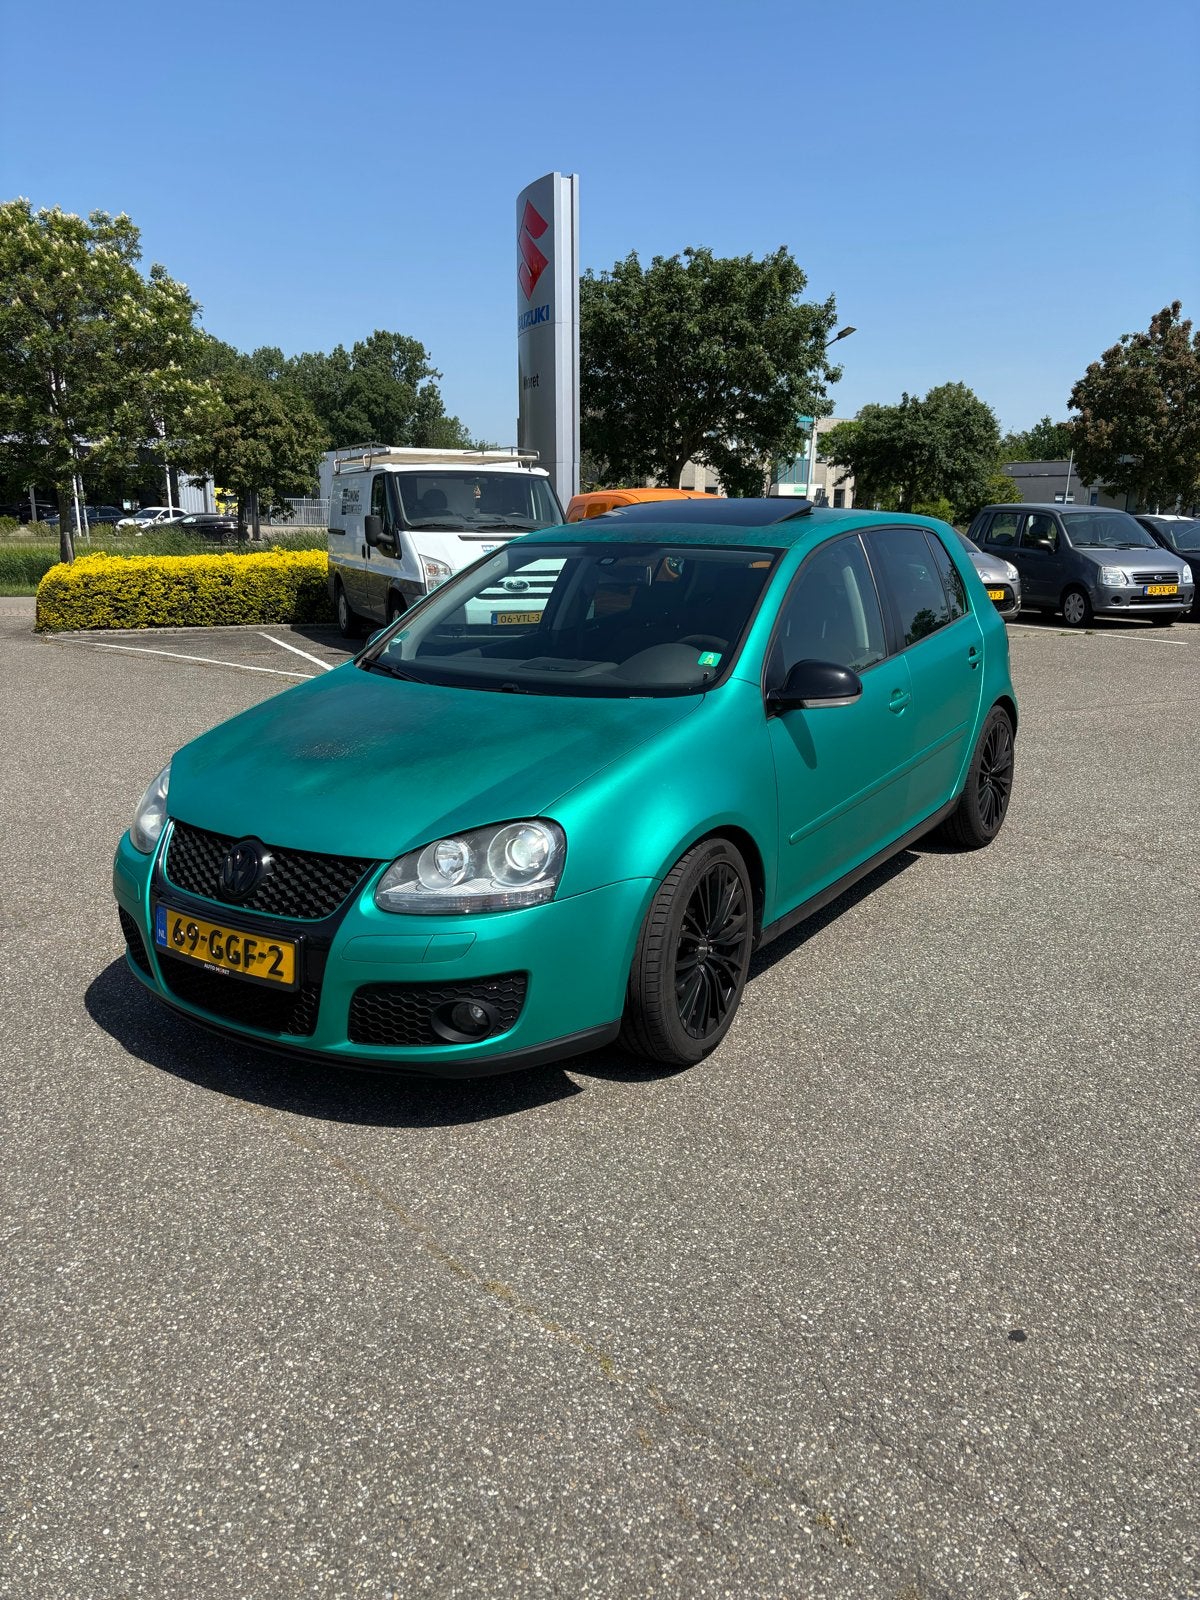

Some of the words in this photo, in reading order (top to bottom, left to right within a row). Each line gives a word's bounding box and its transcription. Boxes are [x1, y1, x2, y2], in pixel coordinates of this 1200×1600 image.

[500, 613, 540, 624] 06-VTL-3
[158, 928, 166, 940] NL
[172, 917, 285, 977] 69-GGF-2
